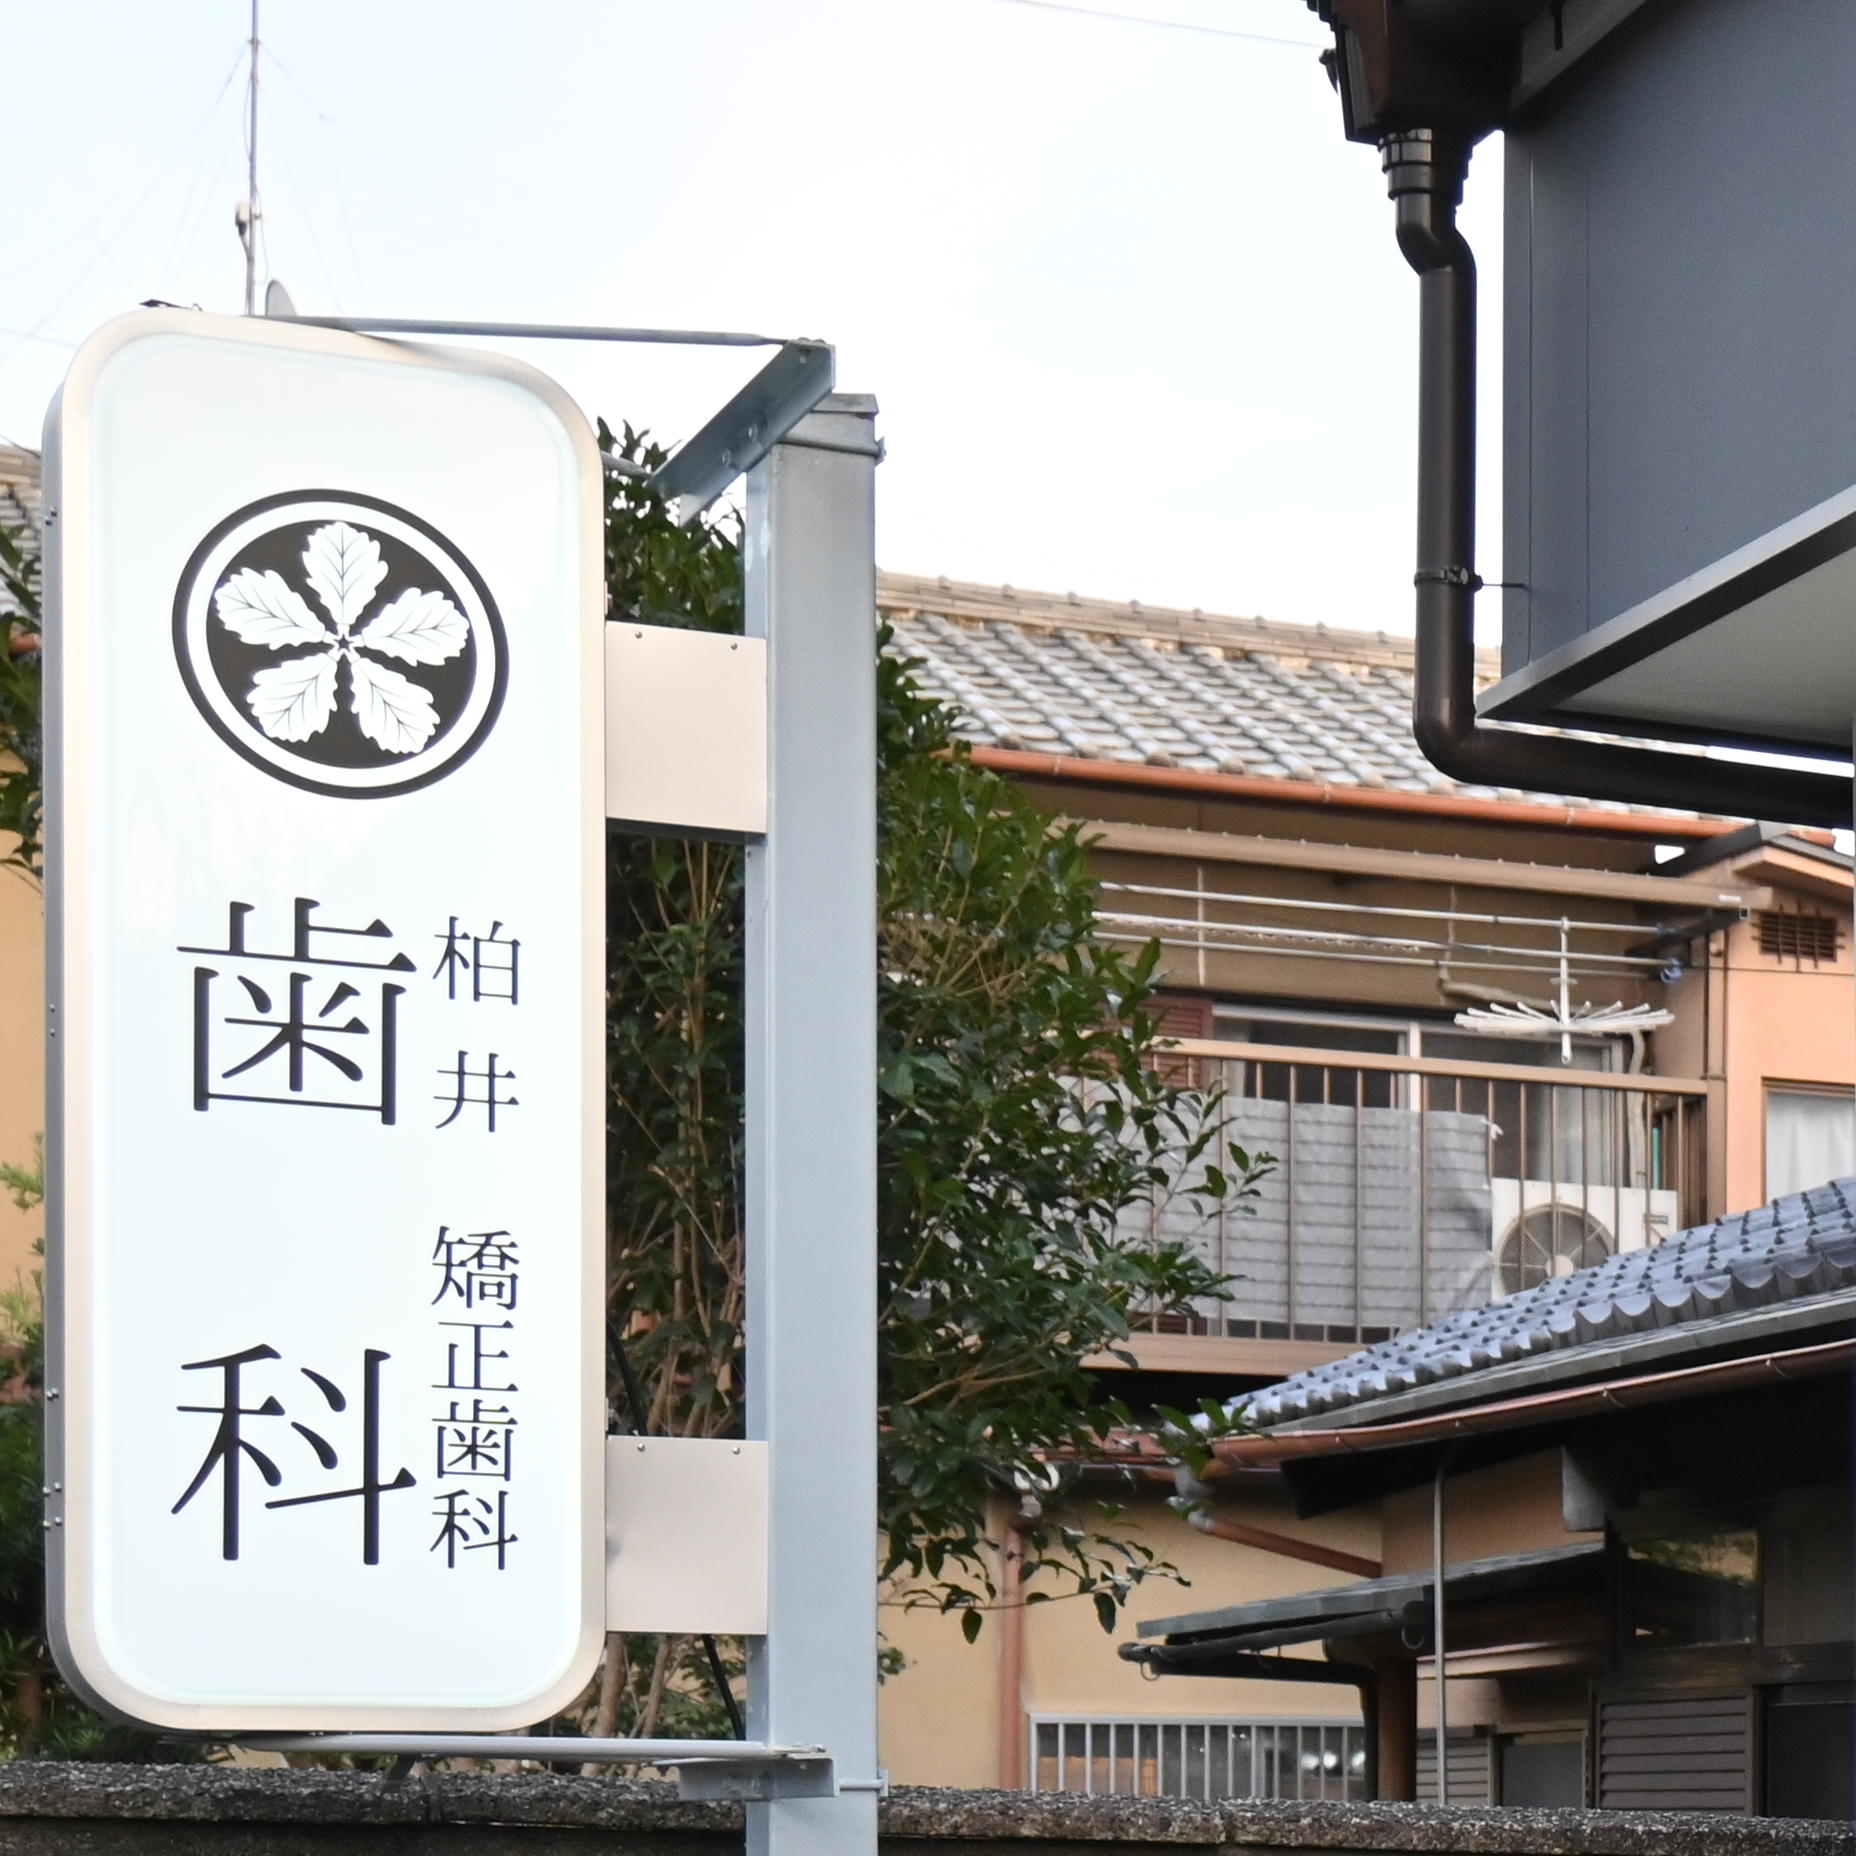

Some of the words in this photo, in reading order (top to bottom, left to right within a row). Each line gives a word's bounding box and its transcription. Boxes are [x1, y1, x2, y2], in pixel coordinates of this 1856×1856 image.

[432, 914, 522, 1135] 柏井
[431, 1225, 522, 1573] 矯正歯科
